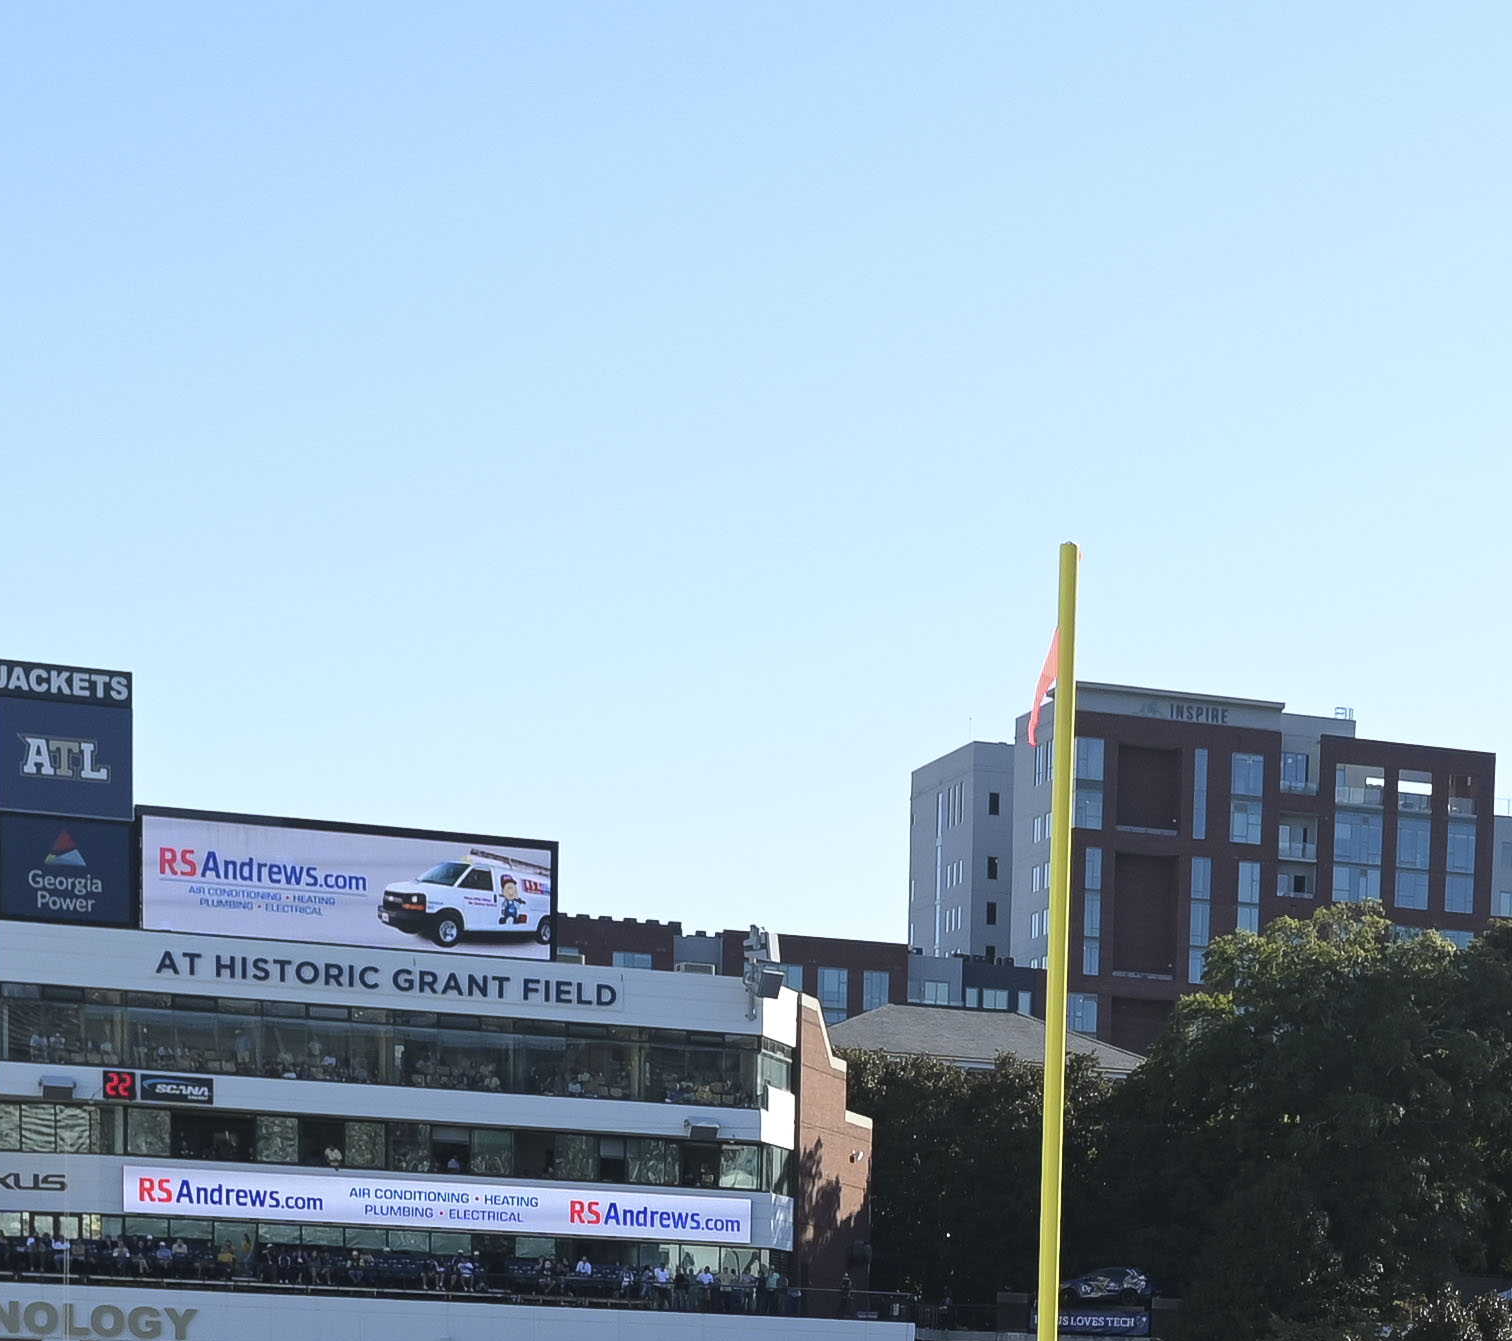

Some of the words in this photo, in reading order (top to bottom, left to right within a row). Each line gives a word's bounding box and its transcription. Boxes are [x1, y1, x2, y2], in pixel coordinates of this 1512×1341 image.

[20, 736, 109, 781] ATL
[28, 869, 102, 894] Georgia
[37, 890, 95, 912] Power
[156, 950, 201, 976] AT
[215, 955, 380, 990] HISTORIC
[392, 968, 510, 1001] GRANT
[522, 978, 618, 1008] FIELD
[105, 1072, 133, 1097] 22
[349, 1187, 371, 1198] AIR
[374, 1188, 470, 1204] CONDITIONING
[484, 1195, 539, 1208] HEATING
[364, 1204, 434, 1219] PLUMBING
[449, 1209, 524, 1223] ELECTRICAL
